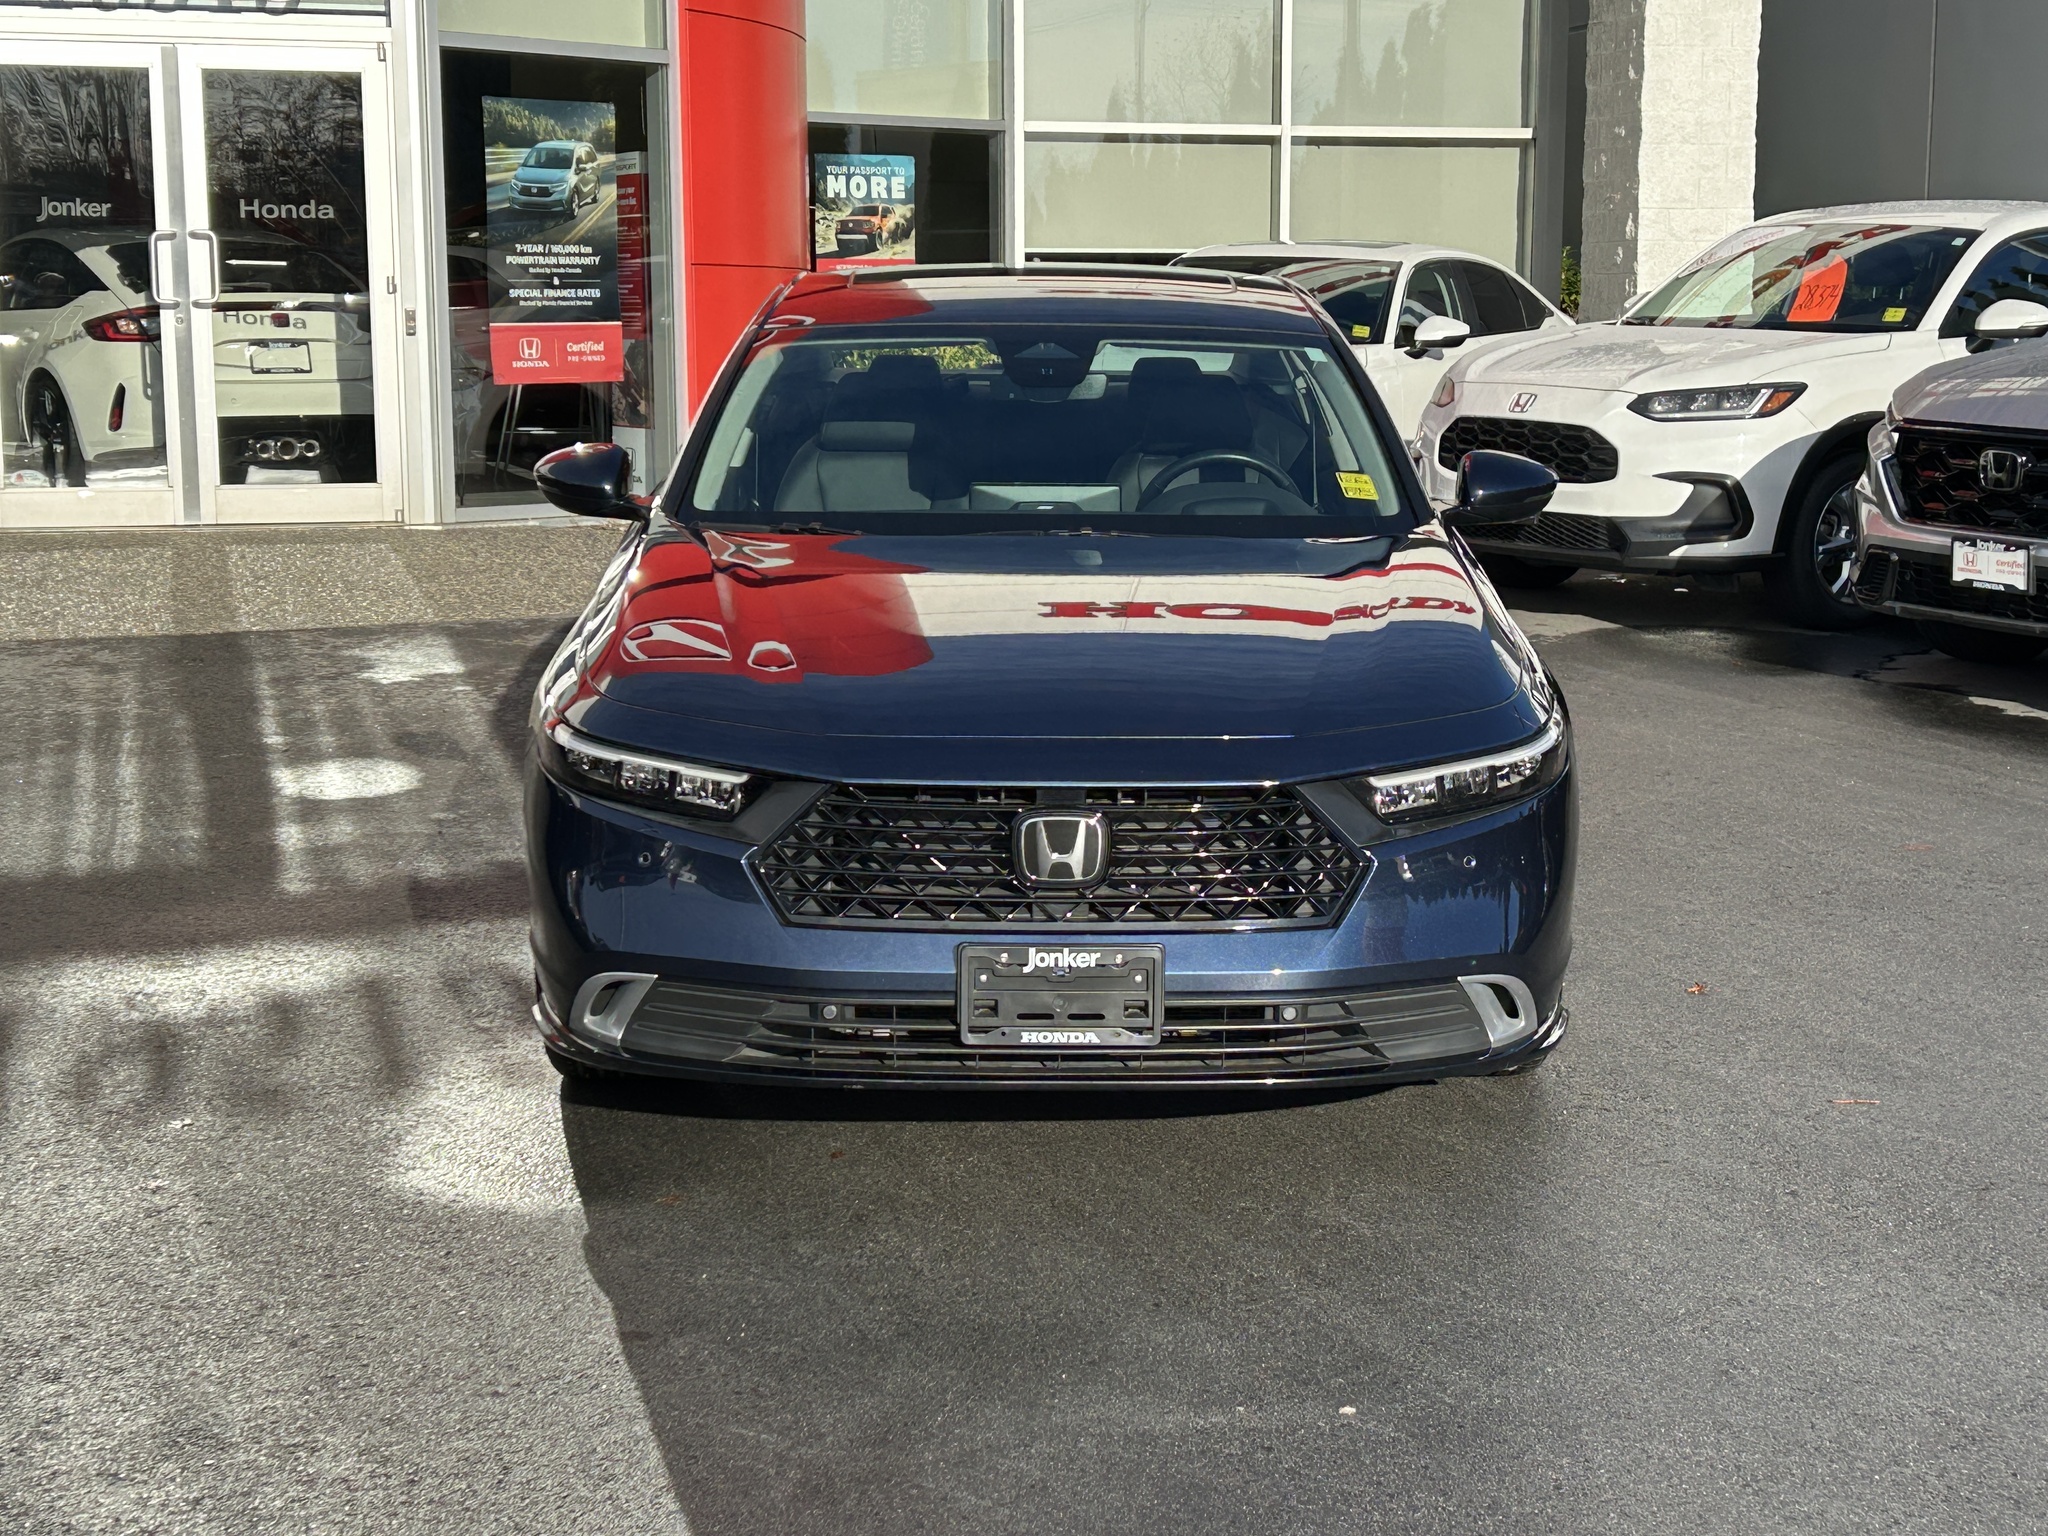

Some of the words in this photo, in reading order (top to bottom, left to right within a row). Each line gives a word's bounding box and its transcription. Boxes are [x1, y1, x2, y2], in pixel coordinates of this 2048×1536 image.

[826, 165, 848, 174] YOUR
[849, 166, 892, 175] PASSPORT
[893, 166, 905, 175] TO
[826, 174, 906, 199] MORE
[36, 196, 112, 222] Jonker
[239, 199, 335, 219] Honda
[505, 255, 558, 265] POWERTRAIN
[508, 288, 543, 298] SPECIAL
[543, 288, 577, 298] FINANCE
[576, 288, 601, 298] RATES
[566, 340, 605, 354] Certified
[512, 360, 550, 368] HONDA
[1973, 539, 2006, 552] Jonker
[1022, 947, 1101, 973] Jonker
[1020, 1031, 1101, 1044] HONDA
